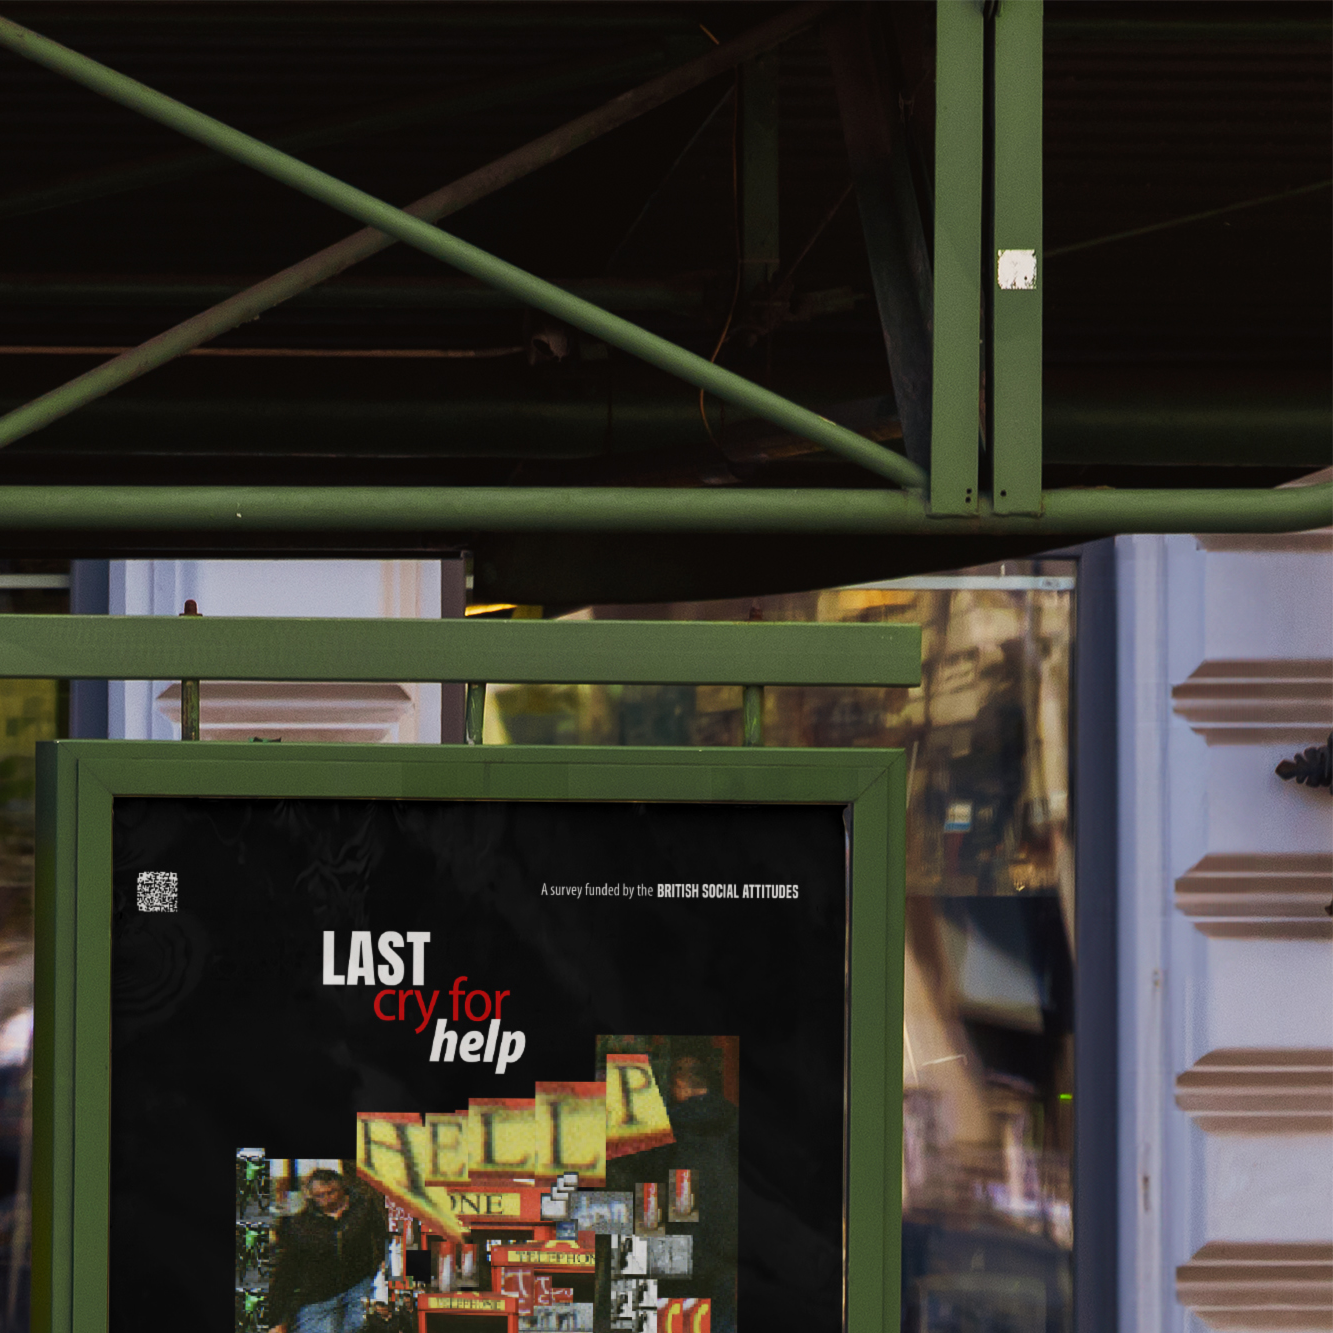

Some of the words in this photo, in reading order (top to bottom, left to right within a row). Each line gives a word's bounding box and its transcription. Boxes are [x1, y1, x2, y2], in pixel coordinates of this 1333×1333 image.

[540, 882, 549, 896] A
[550, 885, 583, 899] survey
[584, 882, 620, 896] funded
[622, 883, 635, 900] by
[636, 883, 654, 897] the
[657, 883, 699, 899] BRITISH
[701, 883, 740, 899] SOCIAL
[742, 883, 799, 899] ATTITUDES
[322, 930, 431, 986] LAST
[373, 988, 440, 1035] cry
[448, 975, 511, 1022] for
[428, 1018, 526, 1075] help
